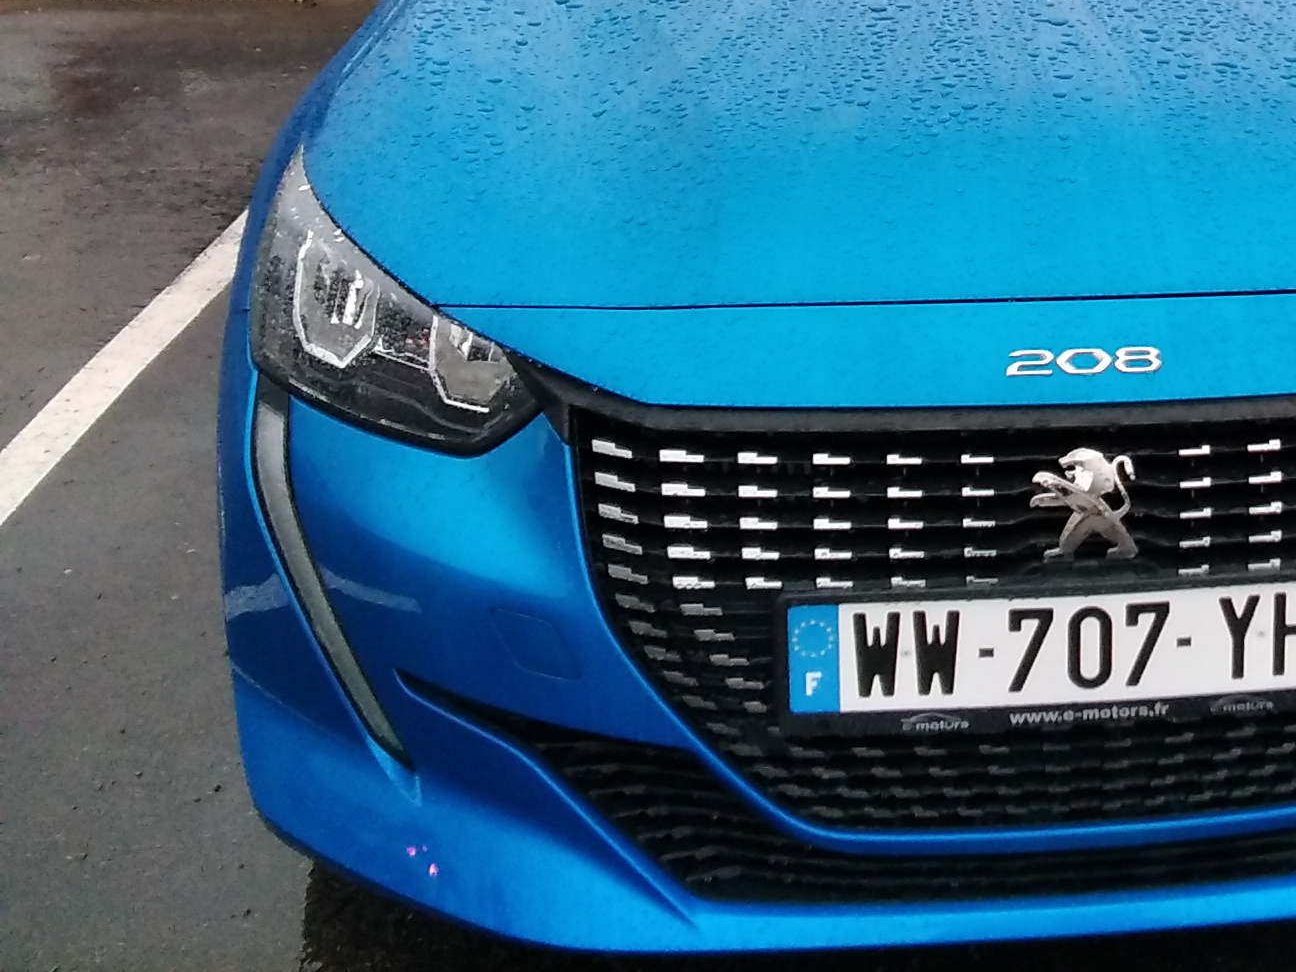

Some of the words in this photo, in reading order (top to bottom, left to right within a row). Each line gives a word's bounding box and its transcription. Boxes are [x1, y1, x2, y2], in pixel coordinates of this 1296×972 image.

[1005, 345, 1163, 377] 208
[805, 671, 822, 697] F
[1009, 701, 1170, 726] www.e-motors.fr
